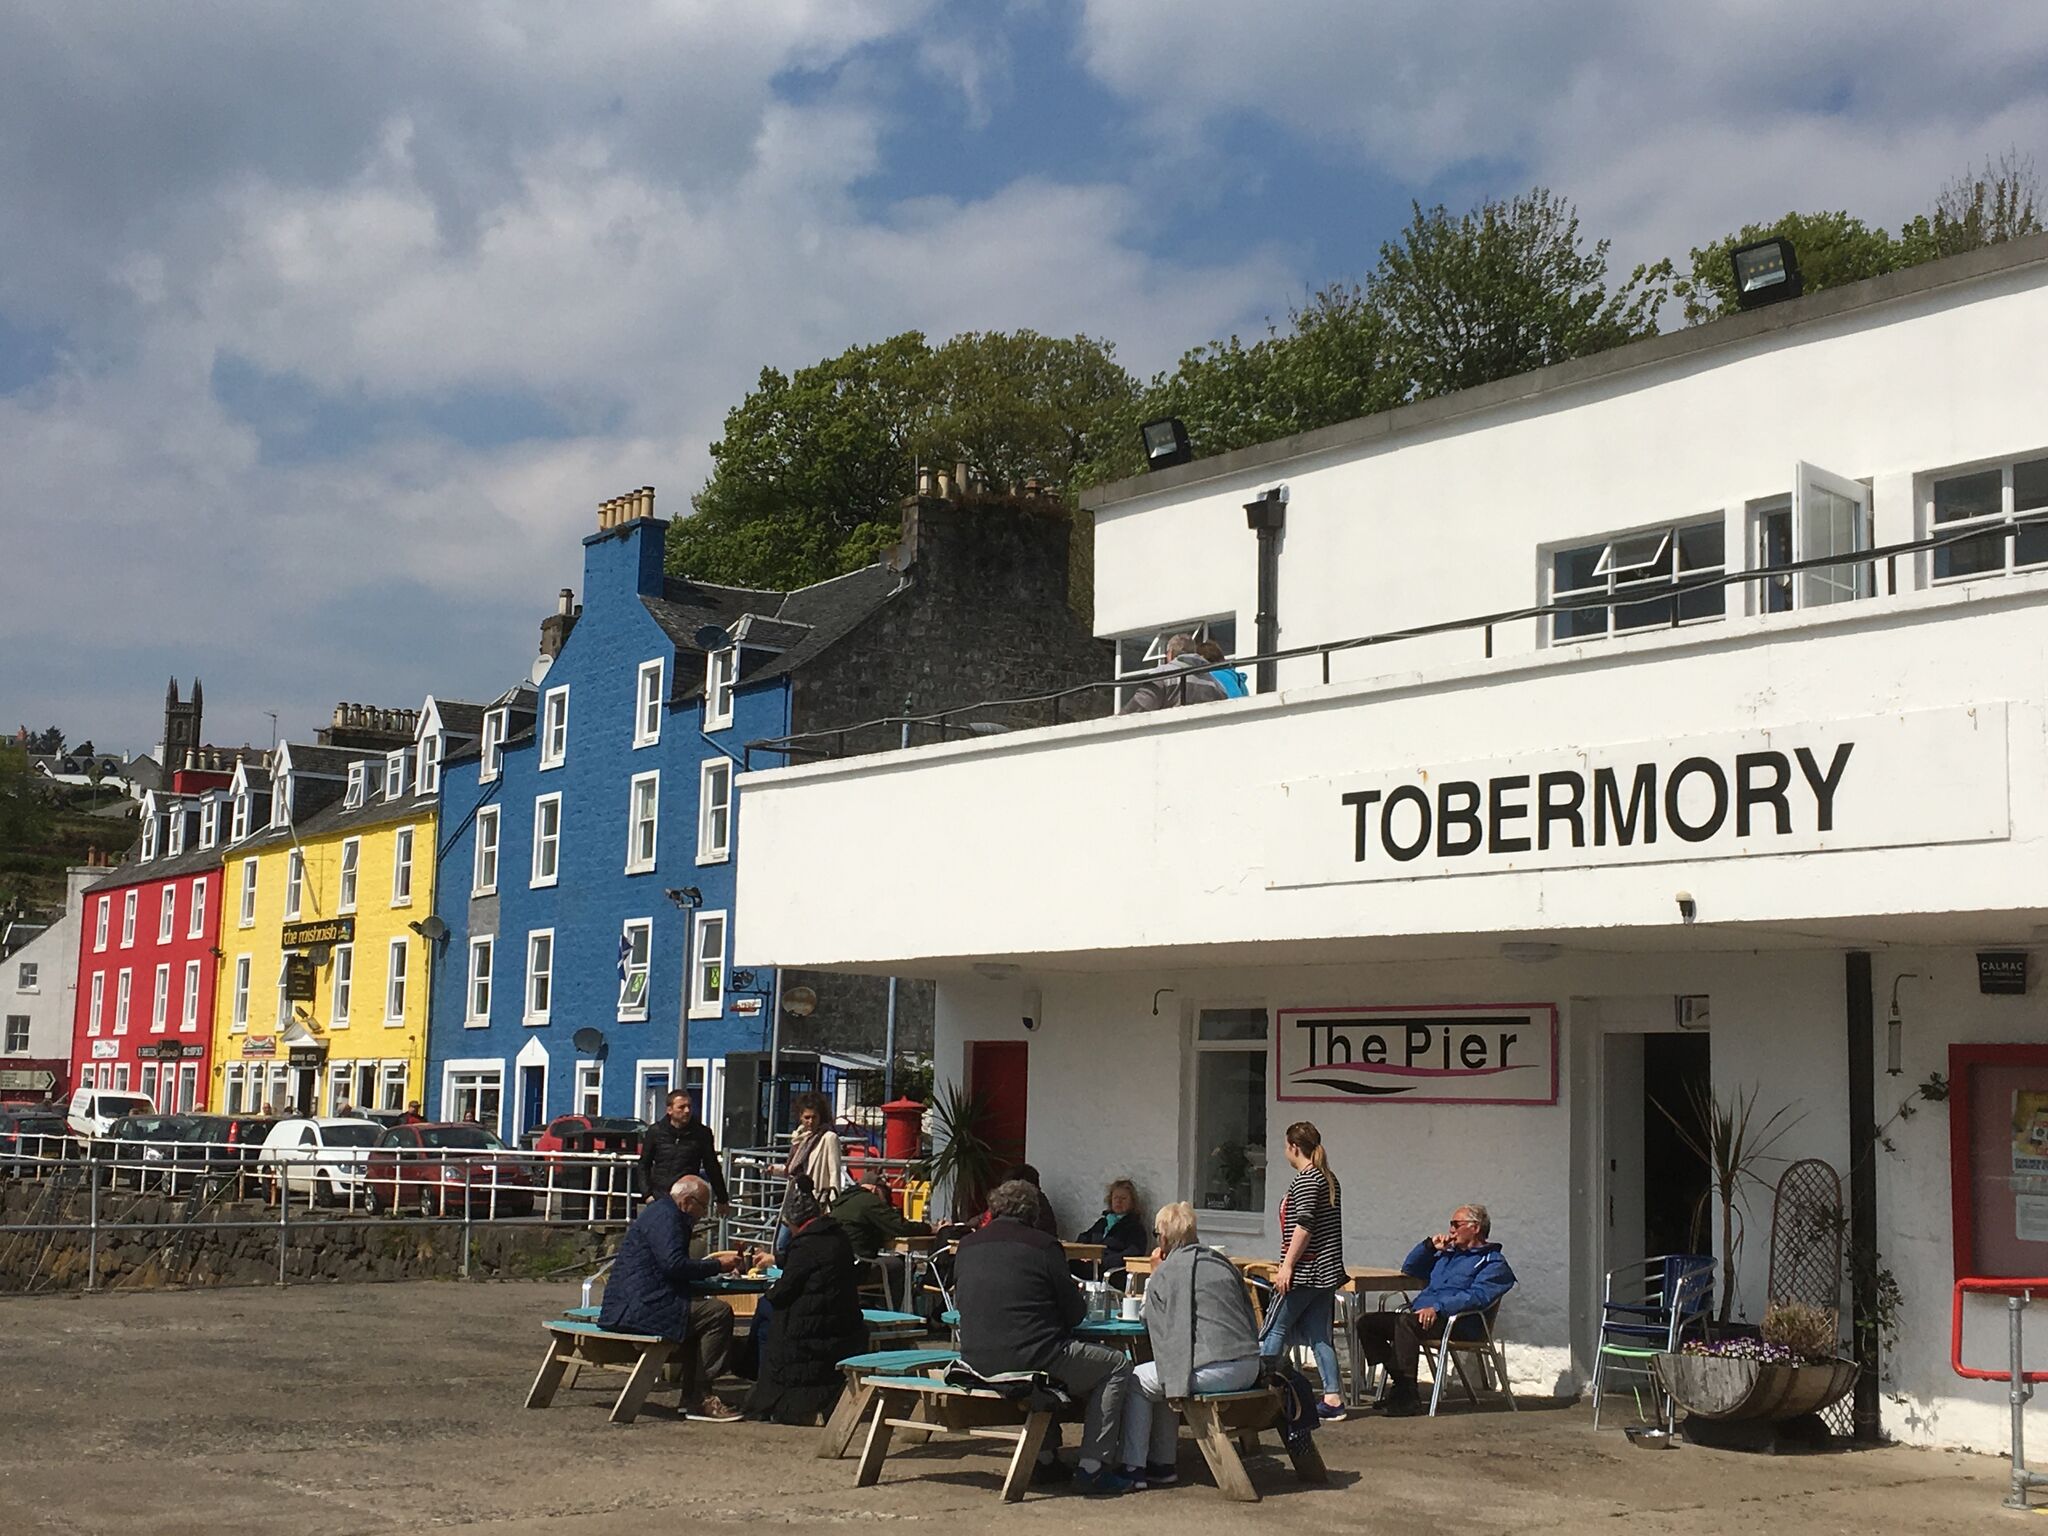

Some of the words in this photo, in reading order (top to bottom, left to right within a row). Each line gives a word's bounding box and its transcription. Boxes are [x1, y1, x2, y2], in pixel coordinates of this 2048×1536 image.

[1342, 743, 1854, 862] TOBERMORY
[1981, 961, 2024, 971] CALMAC
[1297, 1017, 1389, 1068] The
[1404, 1016, 1530, 1070] Pier
